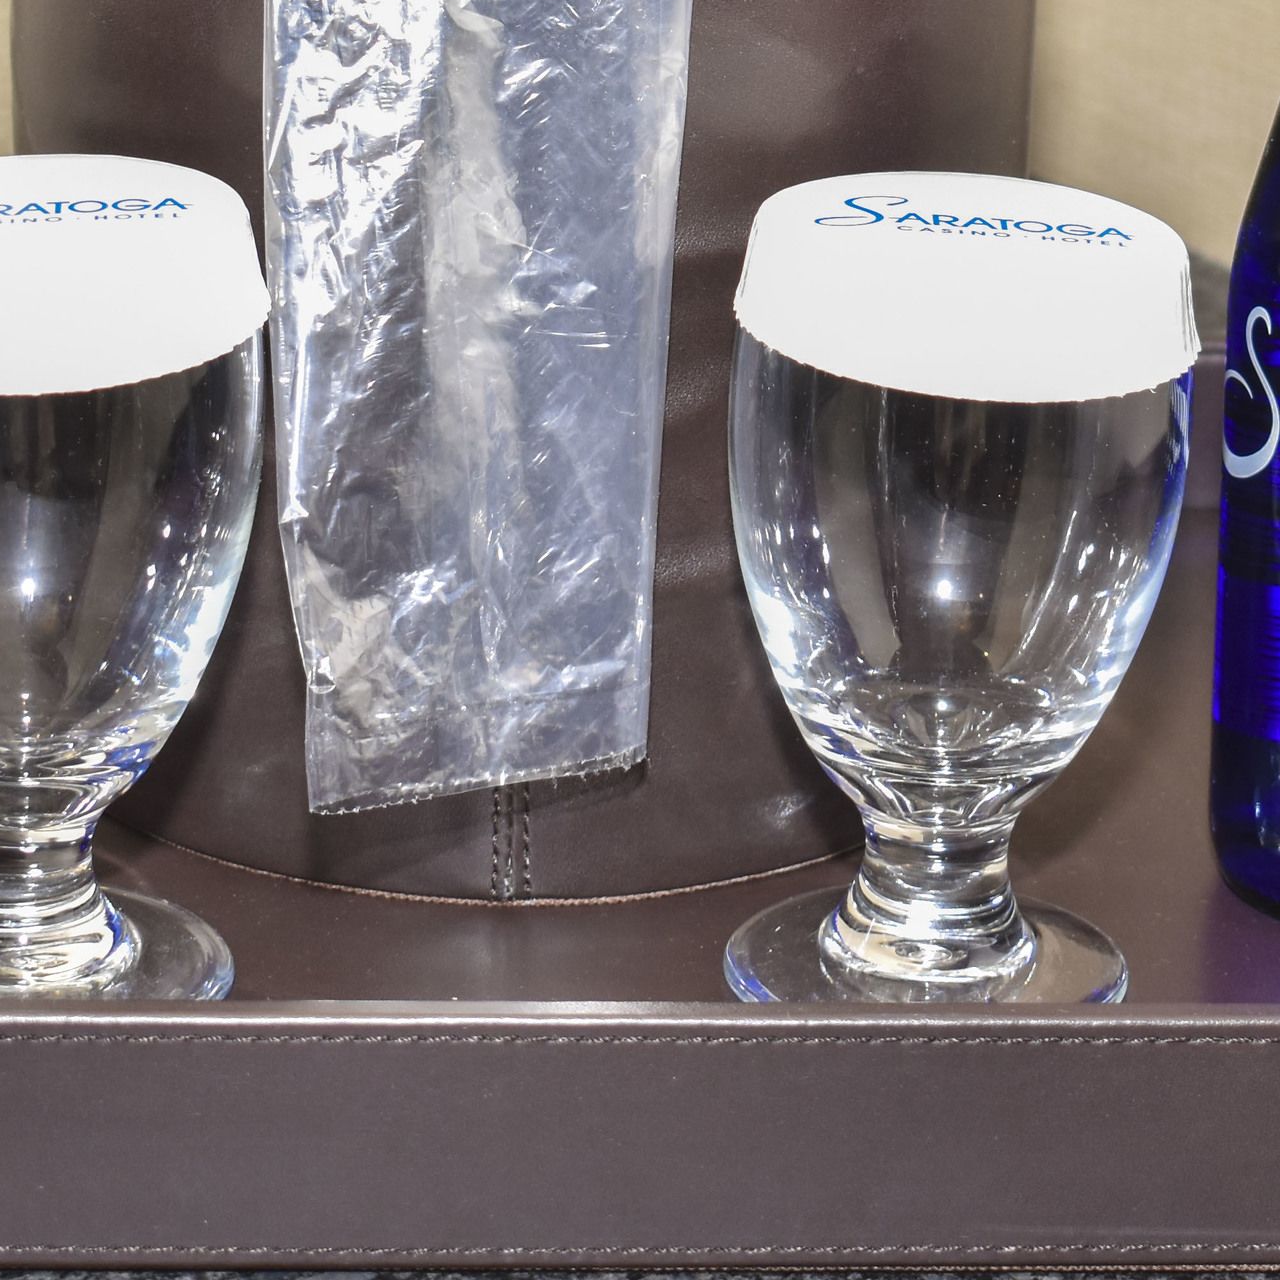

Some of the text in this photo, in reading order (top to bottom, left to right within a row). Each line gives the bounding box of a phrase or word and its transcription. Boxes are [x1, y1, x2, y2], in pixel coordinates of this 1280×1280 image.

[94, 211, 181, 222] HOTEL
[814, 195, 1134, 241] SARATOGA
[897, 225, 1128, 248] CASINO HOTEL
